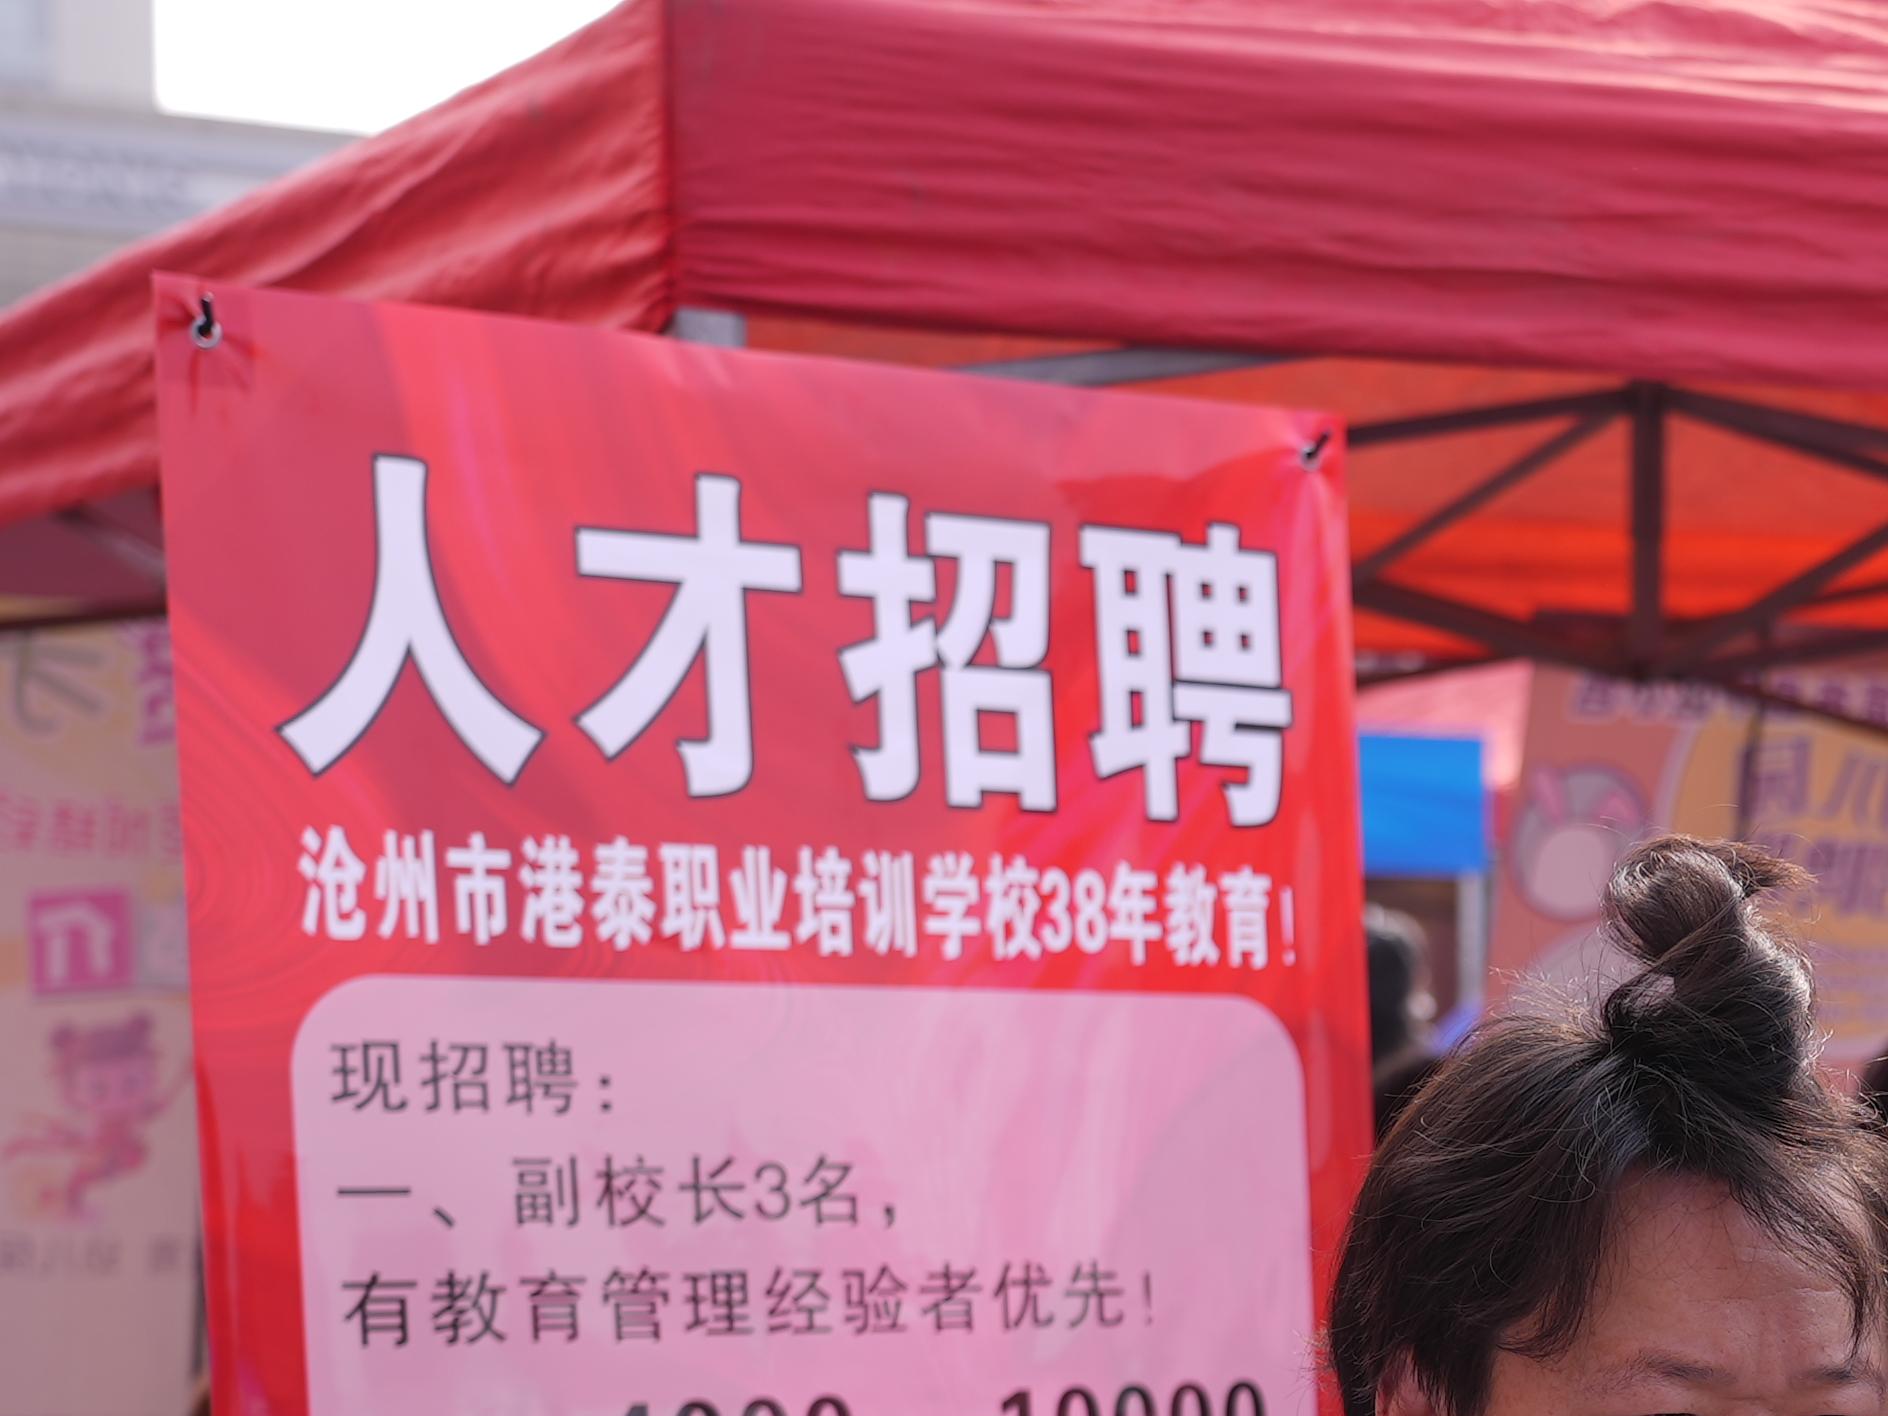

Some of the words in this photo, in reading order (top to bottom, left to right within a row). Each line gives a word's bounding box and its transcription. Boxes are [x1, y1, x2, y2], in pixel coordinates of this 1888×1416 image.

[276, 453, 1292, 827] 人才招聘
[299, 825, 1296, 970] 沧州市港泰职业培训学校38年教育！
[329, 1039, 614, 1117] 现招聘：
[341, 1260, 1153, 1348] 有教育管理经验者优先！
